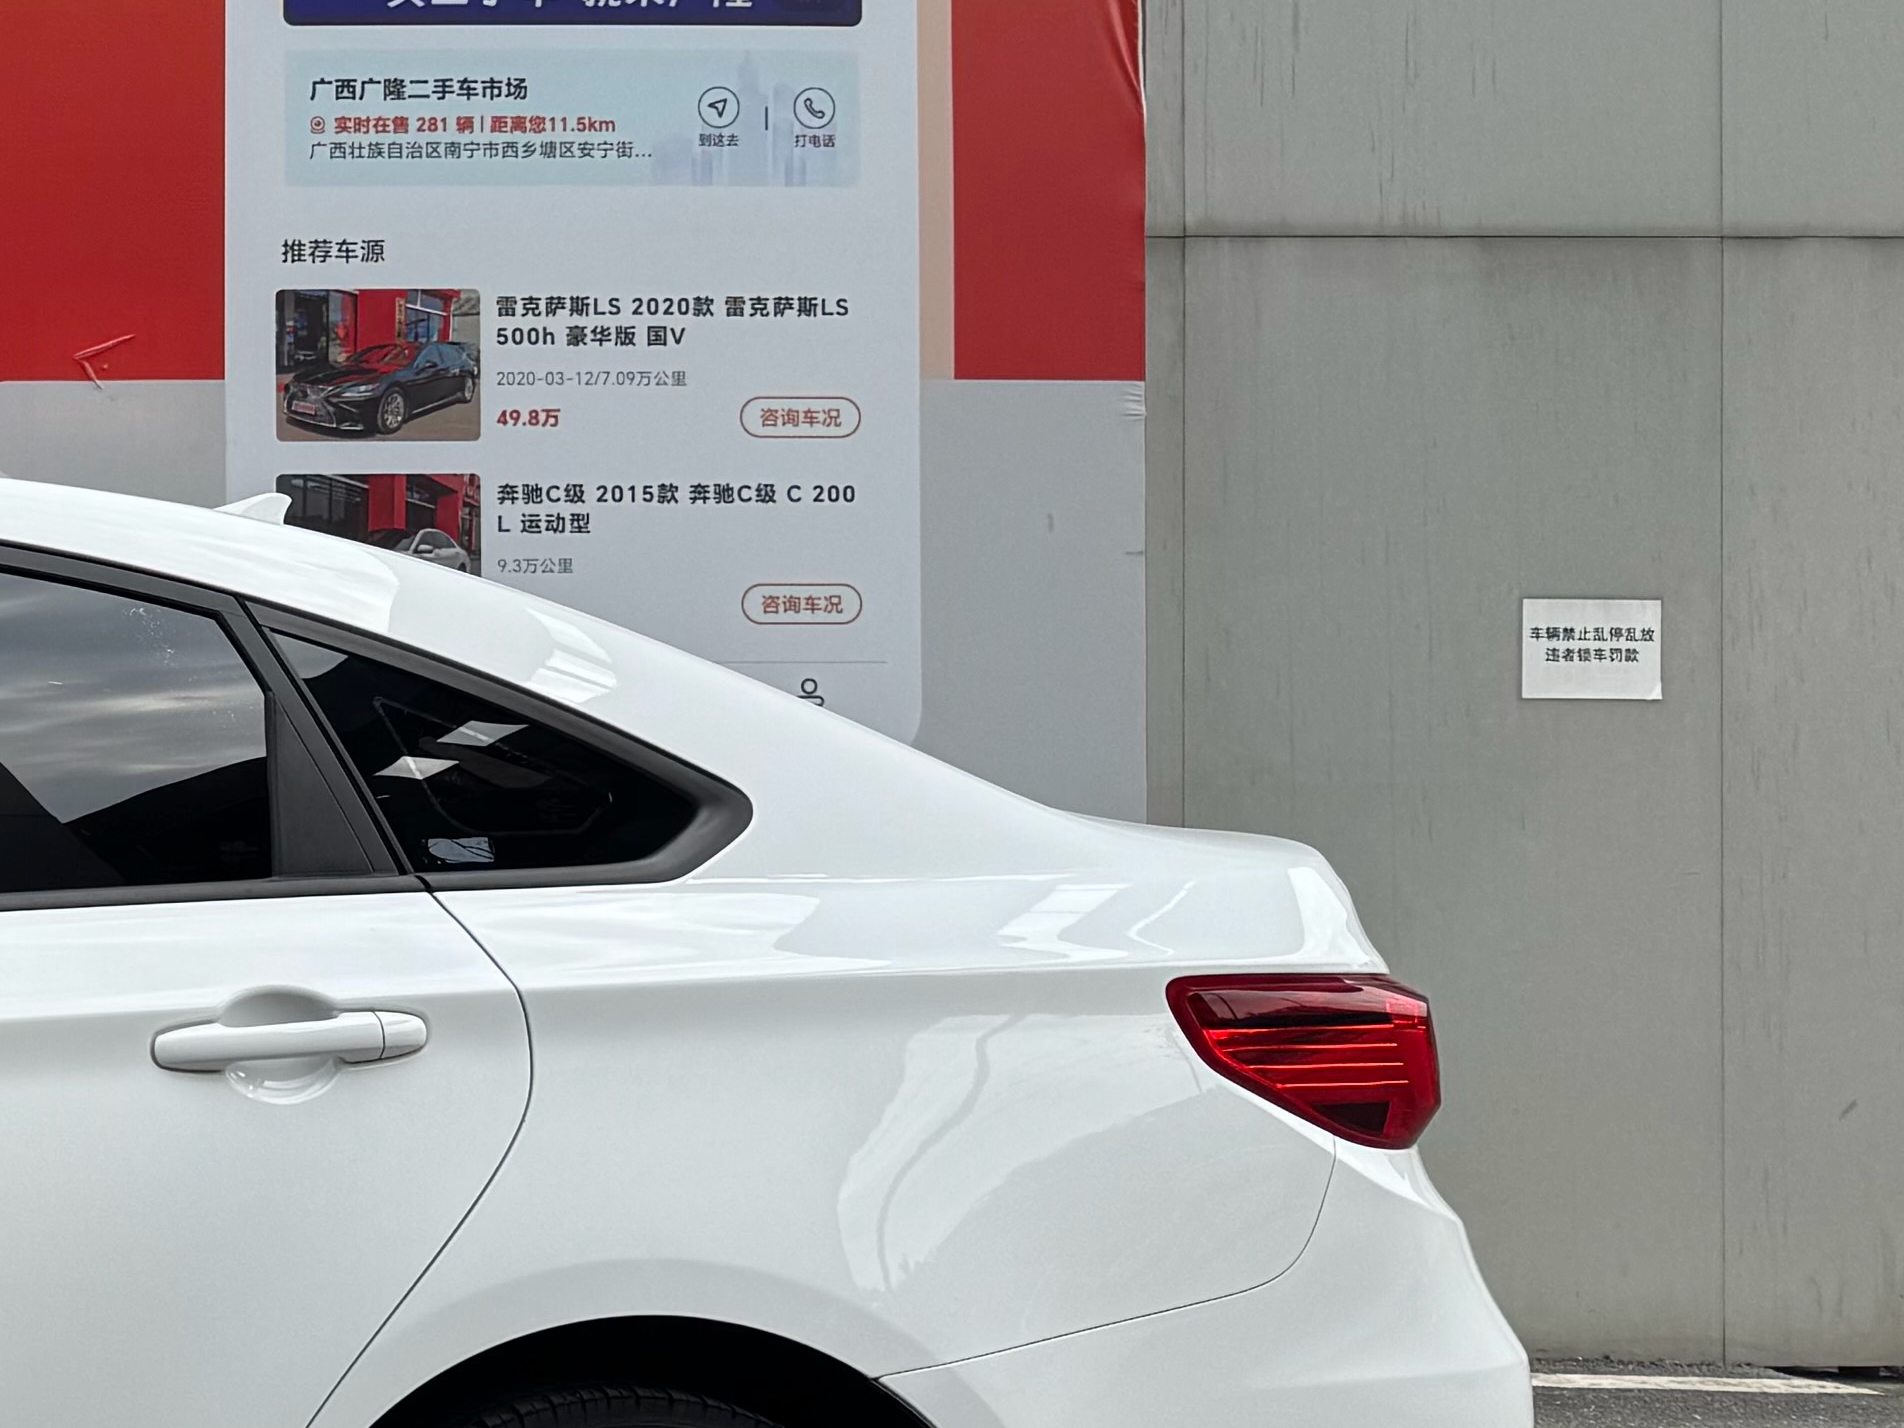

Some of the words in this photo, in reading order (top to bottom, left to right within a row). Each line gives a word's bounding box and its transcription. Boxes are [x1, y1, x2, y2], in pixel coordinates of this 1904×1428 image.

[308, 77, 529, 102] 广西广隆二手车市场
[334, 115, 409, 134] 实时在售
[416, 116, 449, 134] 281
[455, 115, 475, 134] 辆
[698, 133, 739, 148] 到这去
[794, 133, 836, 148] 打电话
[281, 239, 386, 264] 推荐车源
[496, 296, 622, 318] 雷克萨斯LS
[632, 296, 715, 318] 2020款
[724, 296, 849, 318] 雷克萨斯LS
[496, 326, 556, 347] 500h
[565, 325, 637, 348] 豪华版
[647, 326, 686, 348] 国V
[496, 371, 687, 389] 2020-03-12/7.09万公里
[496, 408, 561, 429] 49.8万
[760, 408, 842, 429] 咨询车况
[497, 483, 586, 506] 奔驰C级
[596, 483, 679, 506] 2015款
[689, 483, 778, 506] 奔驰C级
[786, 484, 803, 505] C
[813, 484, 857, 505] 200
[497, 515, 510, 534] L
[520, 512, 592, 536] 运动型
[497, 557, 573, 575] 9.3万公里
[761, 594, 844, 616] 咨询车况
